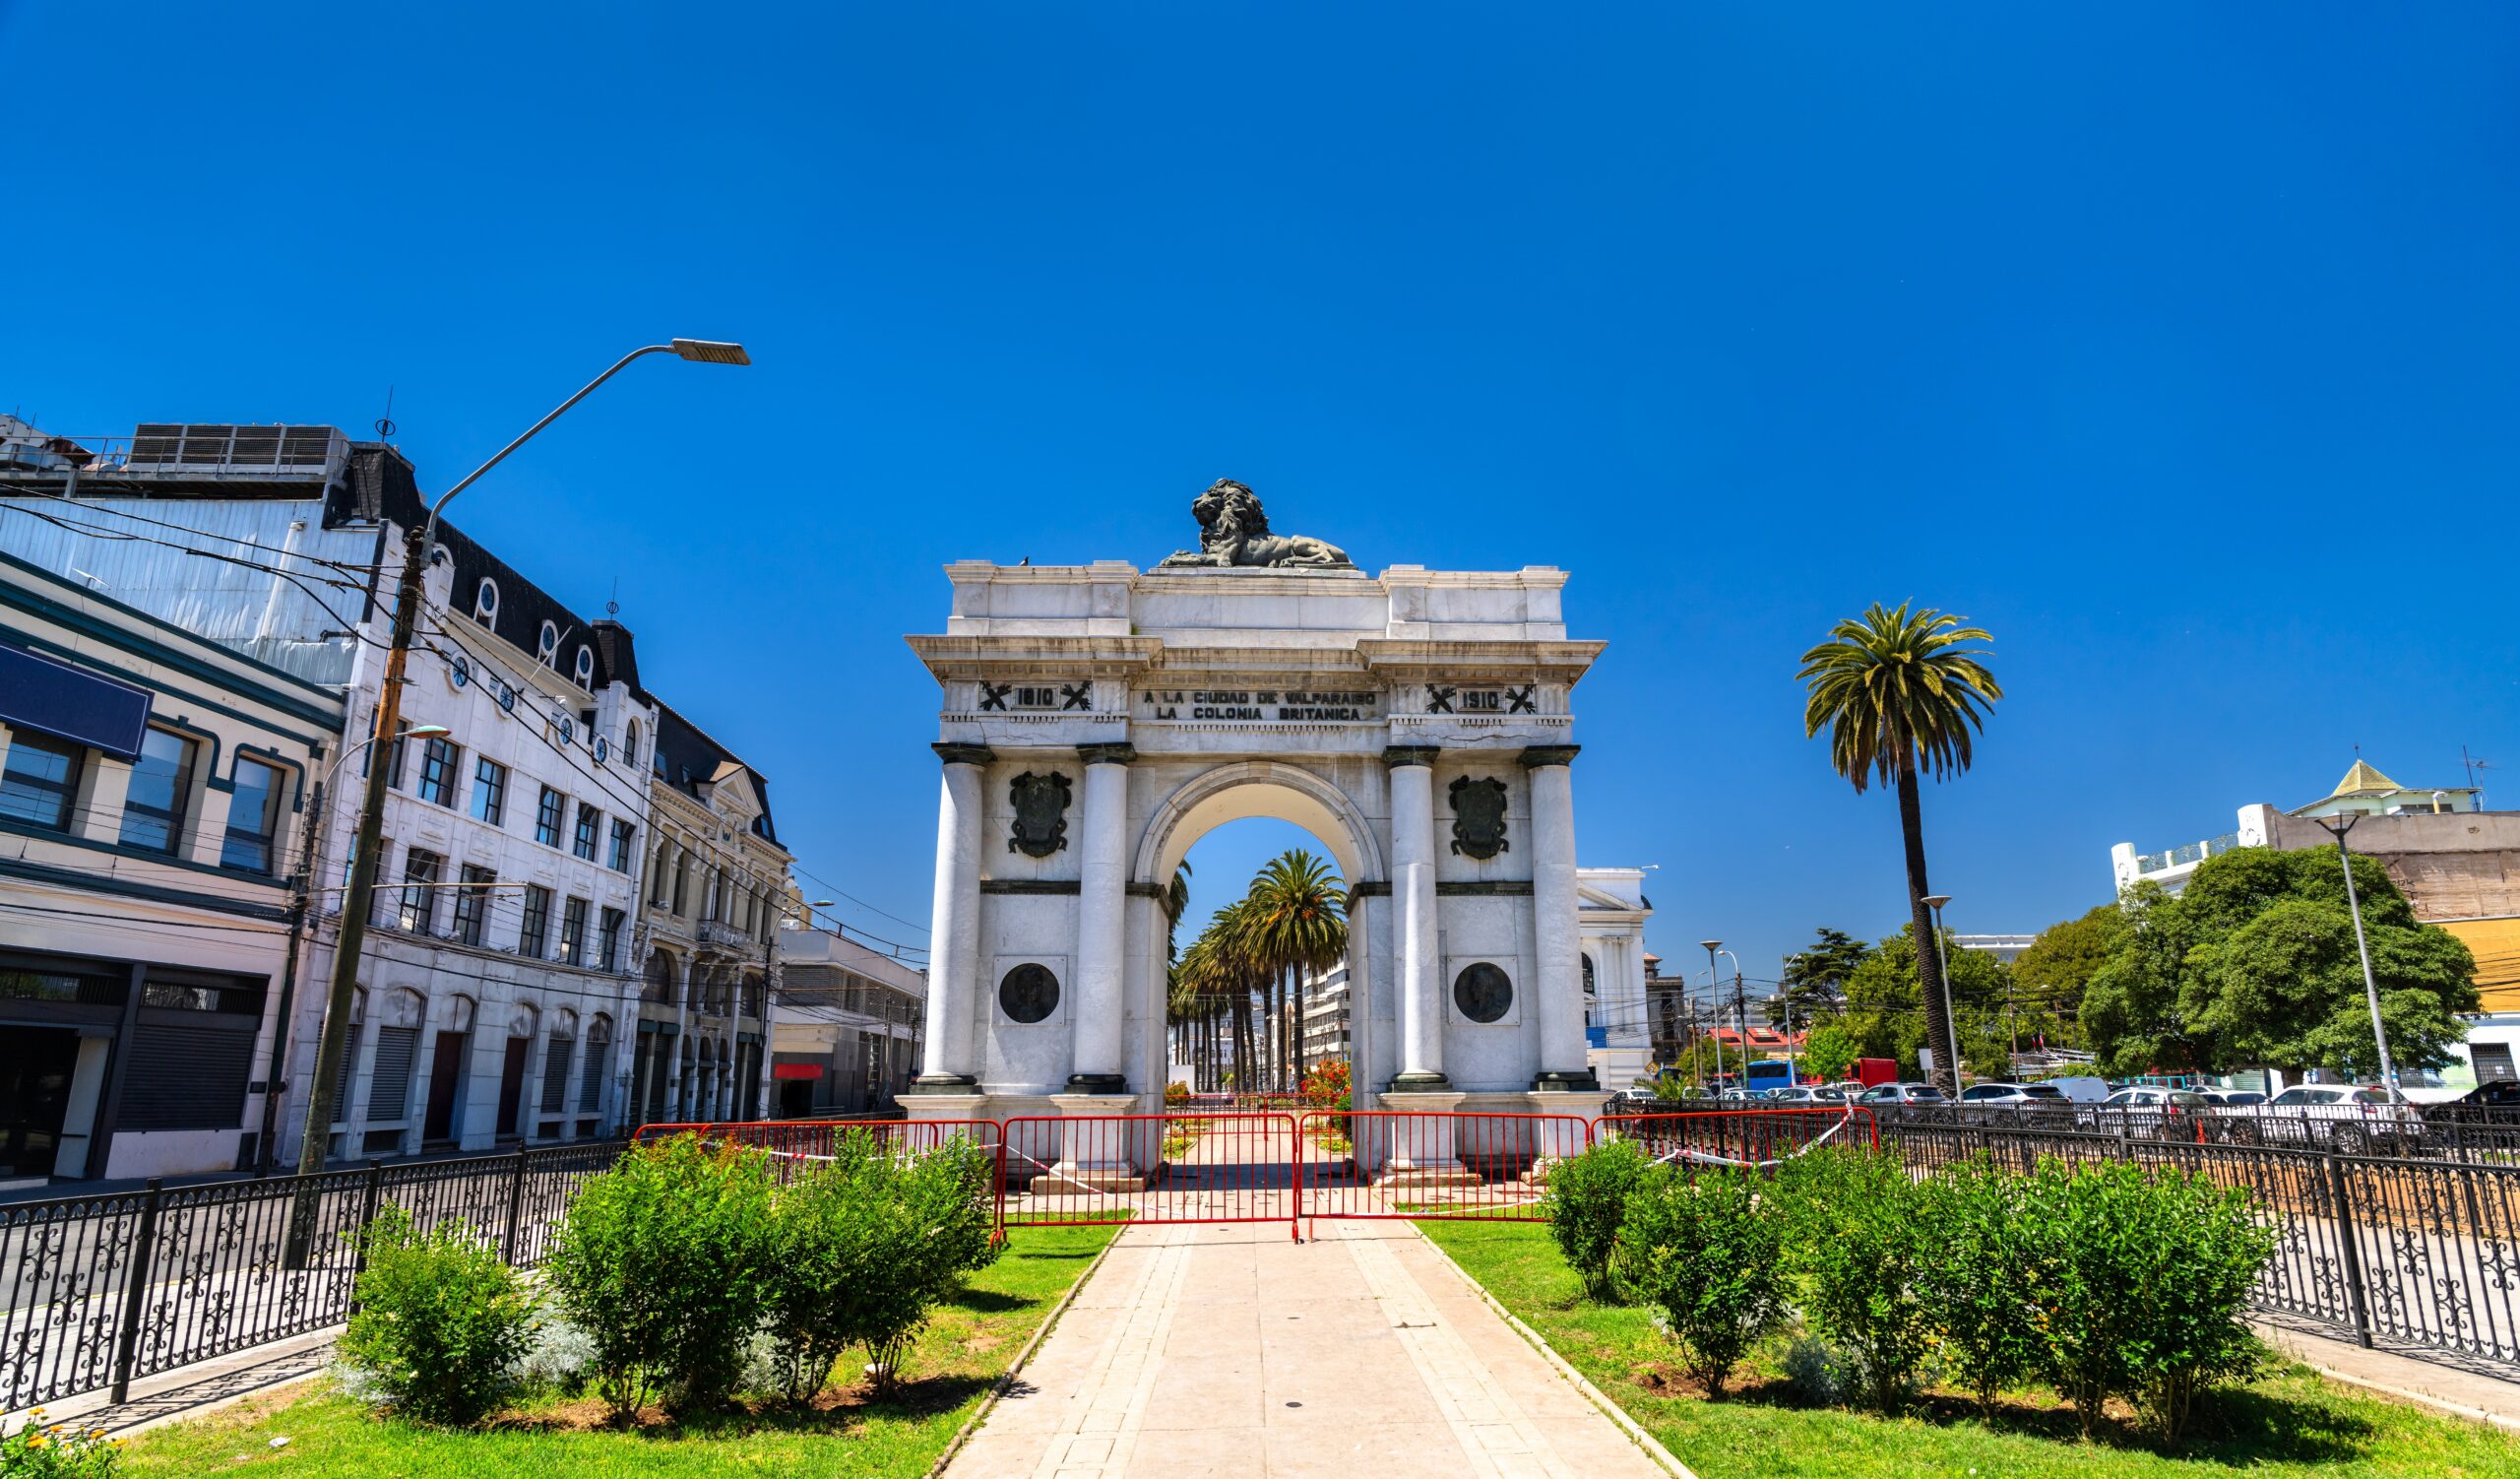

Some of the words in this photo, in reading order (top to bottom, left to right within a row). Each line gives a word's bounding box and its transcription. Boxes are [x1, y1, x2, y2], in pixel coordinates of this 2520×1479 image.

[1019, 688, 1053, 706] 1810
[1144, 691, 1154, 703] A
[1164, 691, 1184, 703] LA
[1193, 691, 1249, 704] CIUDAD
[1257, 691, 1278, 704] DE
[1286, 692, 1375, 705] VALPARAISO
[1463, 691, 1499, 709] 1910
[1158, 707, 1177, 720] LA
[1194, 707, 1263, 720] COLONIA
[1279, 707, 1360, 721] BRITANICA
